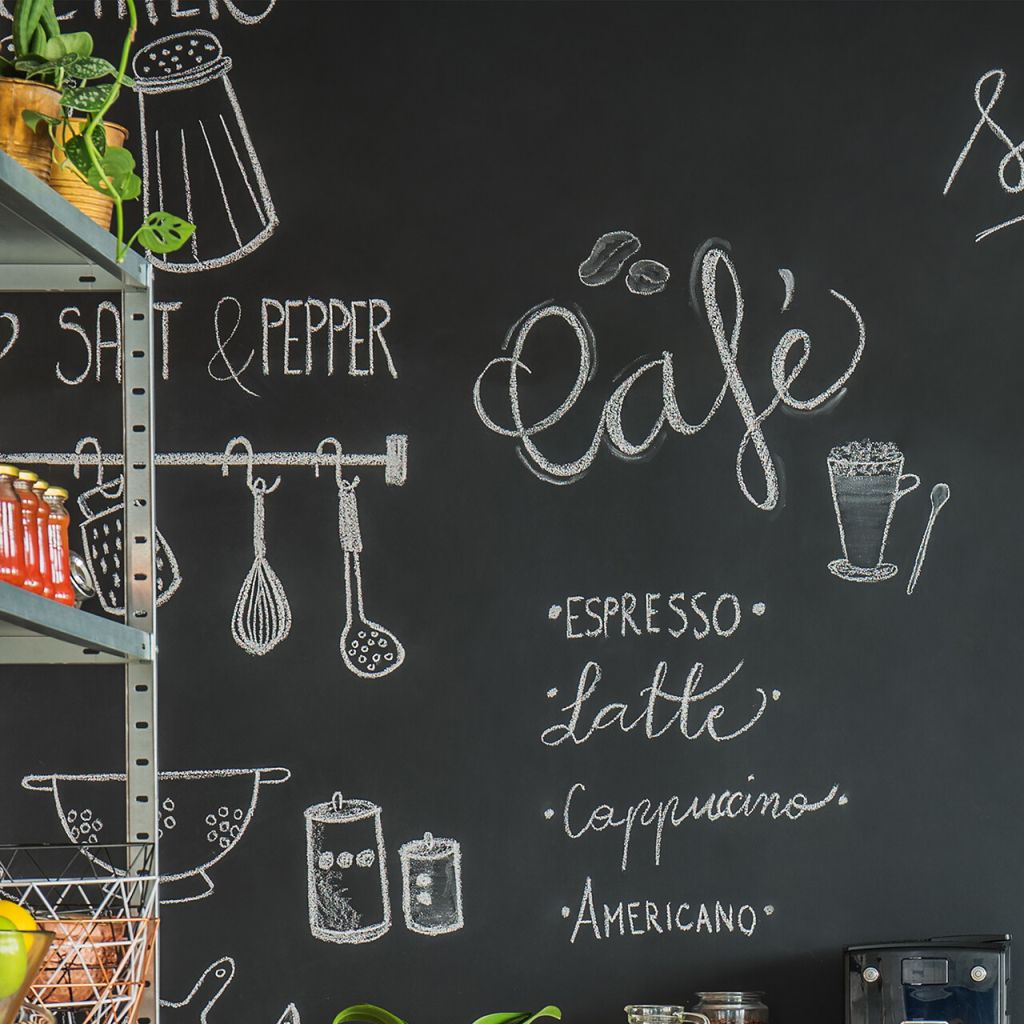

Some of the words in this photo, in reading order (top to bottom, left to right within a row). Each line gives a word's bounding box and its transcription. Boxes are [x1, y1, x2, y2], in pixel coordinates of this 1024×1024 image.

[56, 301, 183, 385] SAT
[207, 296, 261, 397] &
[261, 297, 398, 379] PEPPER
[540, 658, 767, 747] Latte
